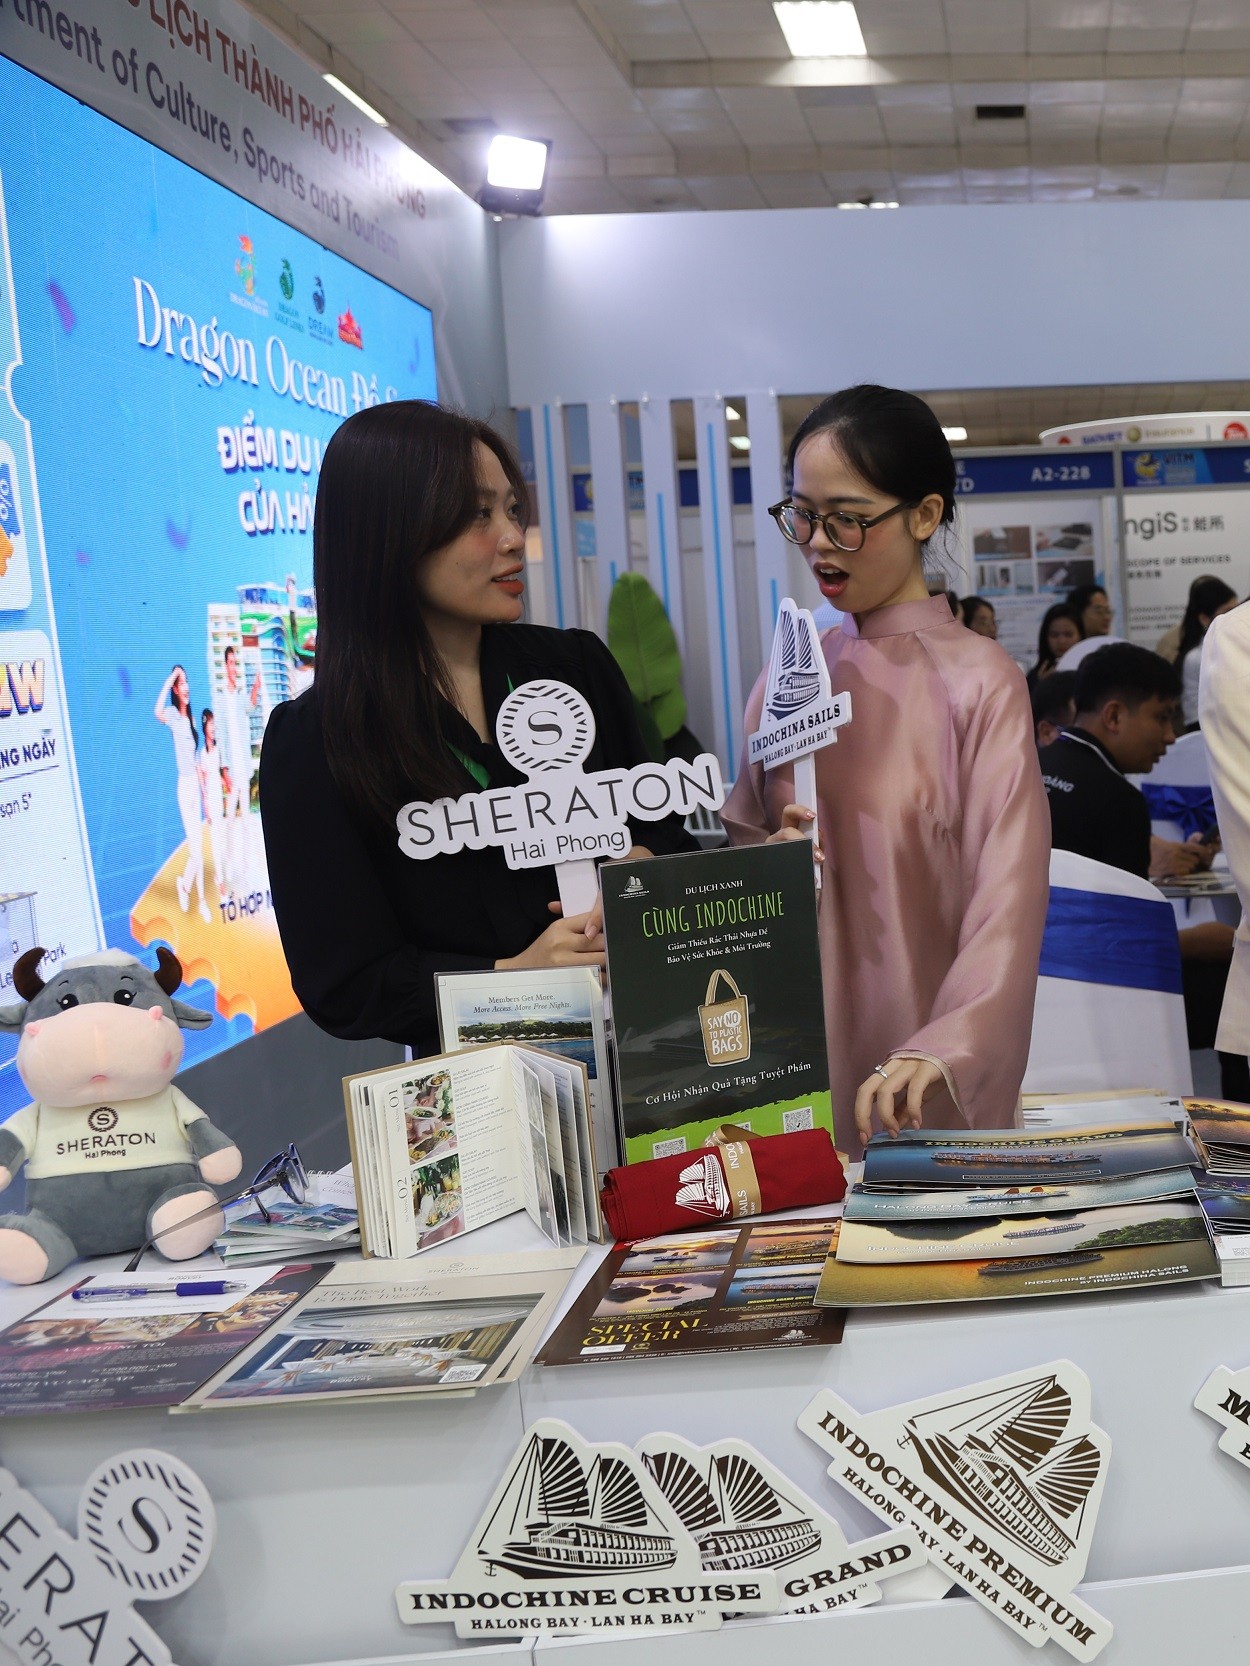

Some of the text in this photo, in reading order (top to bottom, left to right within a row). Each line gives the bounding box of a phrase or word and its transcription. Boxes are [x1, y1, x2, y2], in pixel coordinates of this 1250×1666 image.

[216, 28, 295, 124] THÀNH
[298, 94, 337, 154] PHỐ
[112, 48, 139, 94] of
[243, 127, 306, 201] Sports
[310, 182, 341, 224] and
[344, 198, 401, 262] Tourism
[133, 276, 349, 418] Dragon Ocean
[217, 409, 279, 473] ĐIỂM
[280, 430, 312, 475] DU
[1031, 466, 1091, 483] A2-228
[1181, 554, 1231, 564] SERVICES
[528, 711, 563, 745] S
[752, 703, 841, 754] INDOCHINA SAILS
[22, 737, 56, 762] NGÀY
[764, 746, 784, 763] HALONG
[407, 765, 717, 846] SHERATON
[511, 831, 626, 861] Hai Phong
[685, 879, 743, 895] DU LỊCH XANH
[641, 891, 785, 939] CÙNG INDOCHINE
[725, 946, 731, 954] &
[474, 1005, 490, 1014] More
[492, 1004, 513, 1013] Access.
[514, 1003, 531, 1011] More
[549, 1001, 572, 1010] Nights.
[488, 993, 556, 1004] Members Get More.
[707, 1011, 740, 1030] SAY NO
[709, 1026, 743, 1040] TO PLASTIC
[711, 1034, 743, 1056] BAGS
[645, 1094, 660, 1106] Cơ
[663, 1089, 681, 1102] Hội
[683, 1083, 709, 1098] Nhận
[734, 1073, 757, 1087] Tặng
[758, 1068, 785, 1082] Tuyệt
[97, 1113, 110, 1126] S
[56, 1132, 156, 1155] SHERATON
[85, 1148, 127, 1159] Hai Phong
[737, 1190, 749, 1215] SAILS
[1024, 1265, 1188, 1286] INDOCHINE PREMIUM HALONG
[1093, 1273, 1156, 1283] INDOCHINA
[331, 1294, 373, 1303] Done
[378, 1290, 445, 1300] Together
[392, 1284, 430, 1292] Work
[589, 1318, 709, 1335] SPECIAL
[581, 1330, 681, 1346] OFFER
[816, 1409, 1098, 1648] INDOCHINE PREMIUM
[842, 1466, 1000, 1605] HALONG LAN HA
[783, 1542, 915, 1599] GRAND
[409, 1583, 762, 1611] INDOCHINE CRUISE
[470, 1613, 658, 1630] HALONG BAY LAN HA
